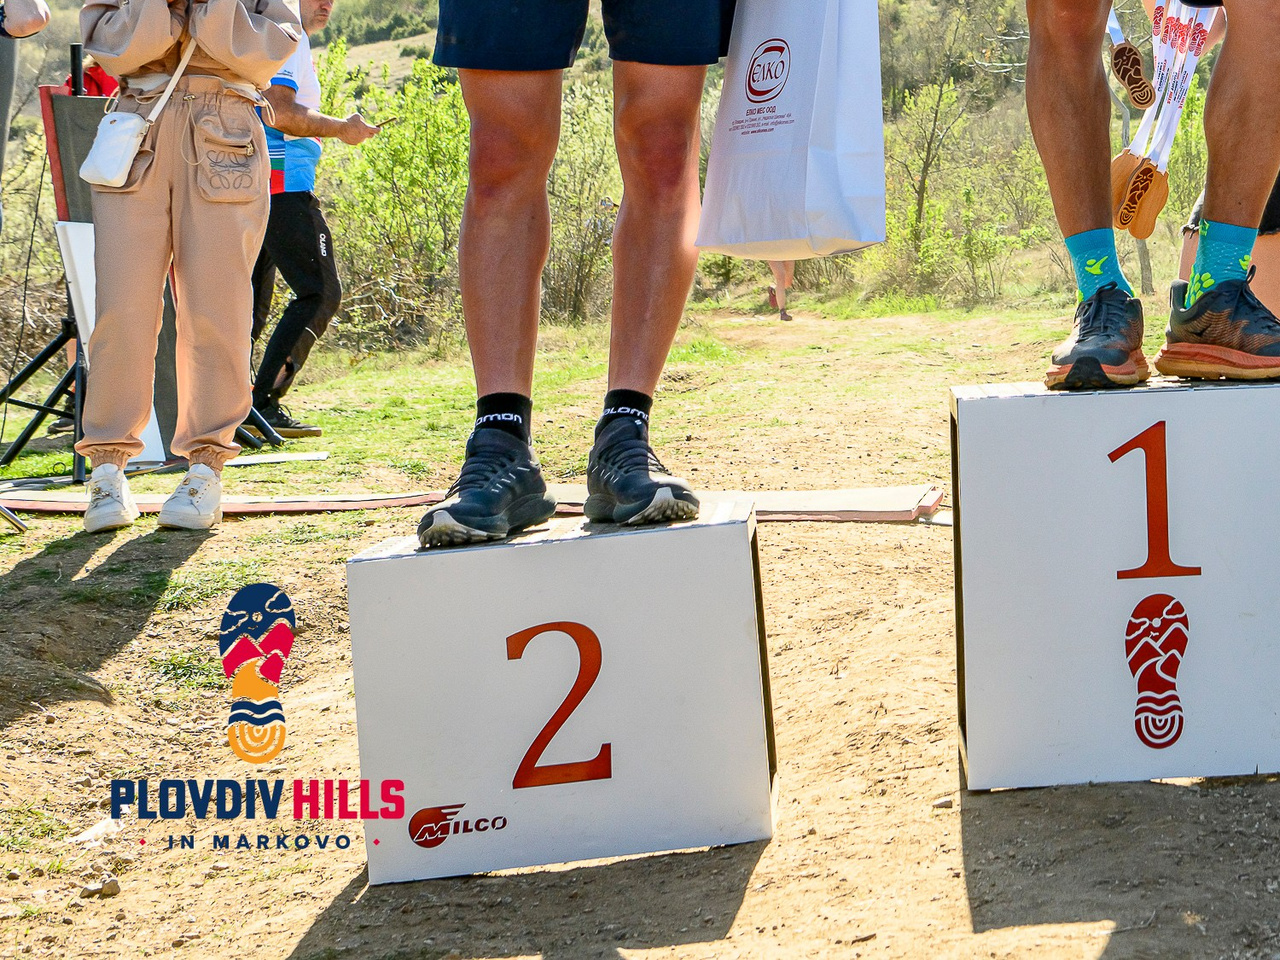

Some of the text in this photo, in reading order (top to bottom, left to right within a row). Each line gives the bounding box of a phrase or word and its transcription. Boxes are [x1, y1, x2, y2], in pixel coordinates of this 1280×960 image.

[1107, 420, 1202, 580] 1
[506, 621, 612, 790] 2
[413, 814, 508, 843] MILCO
